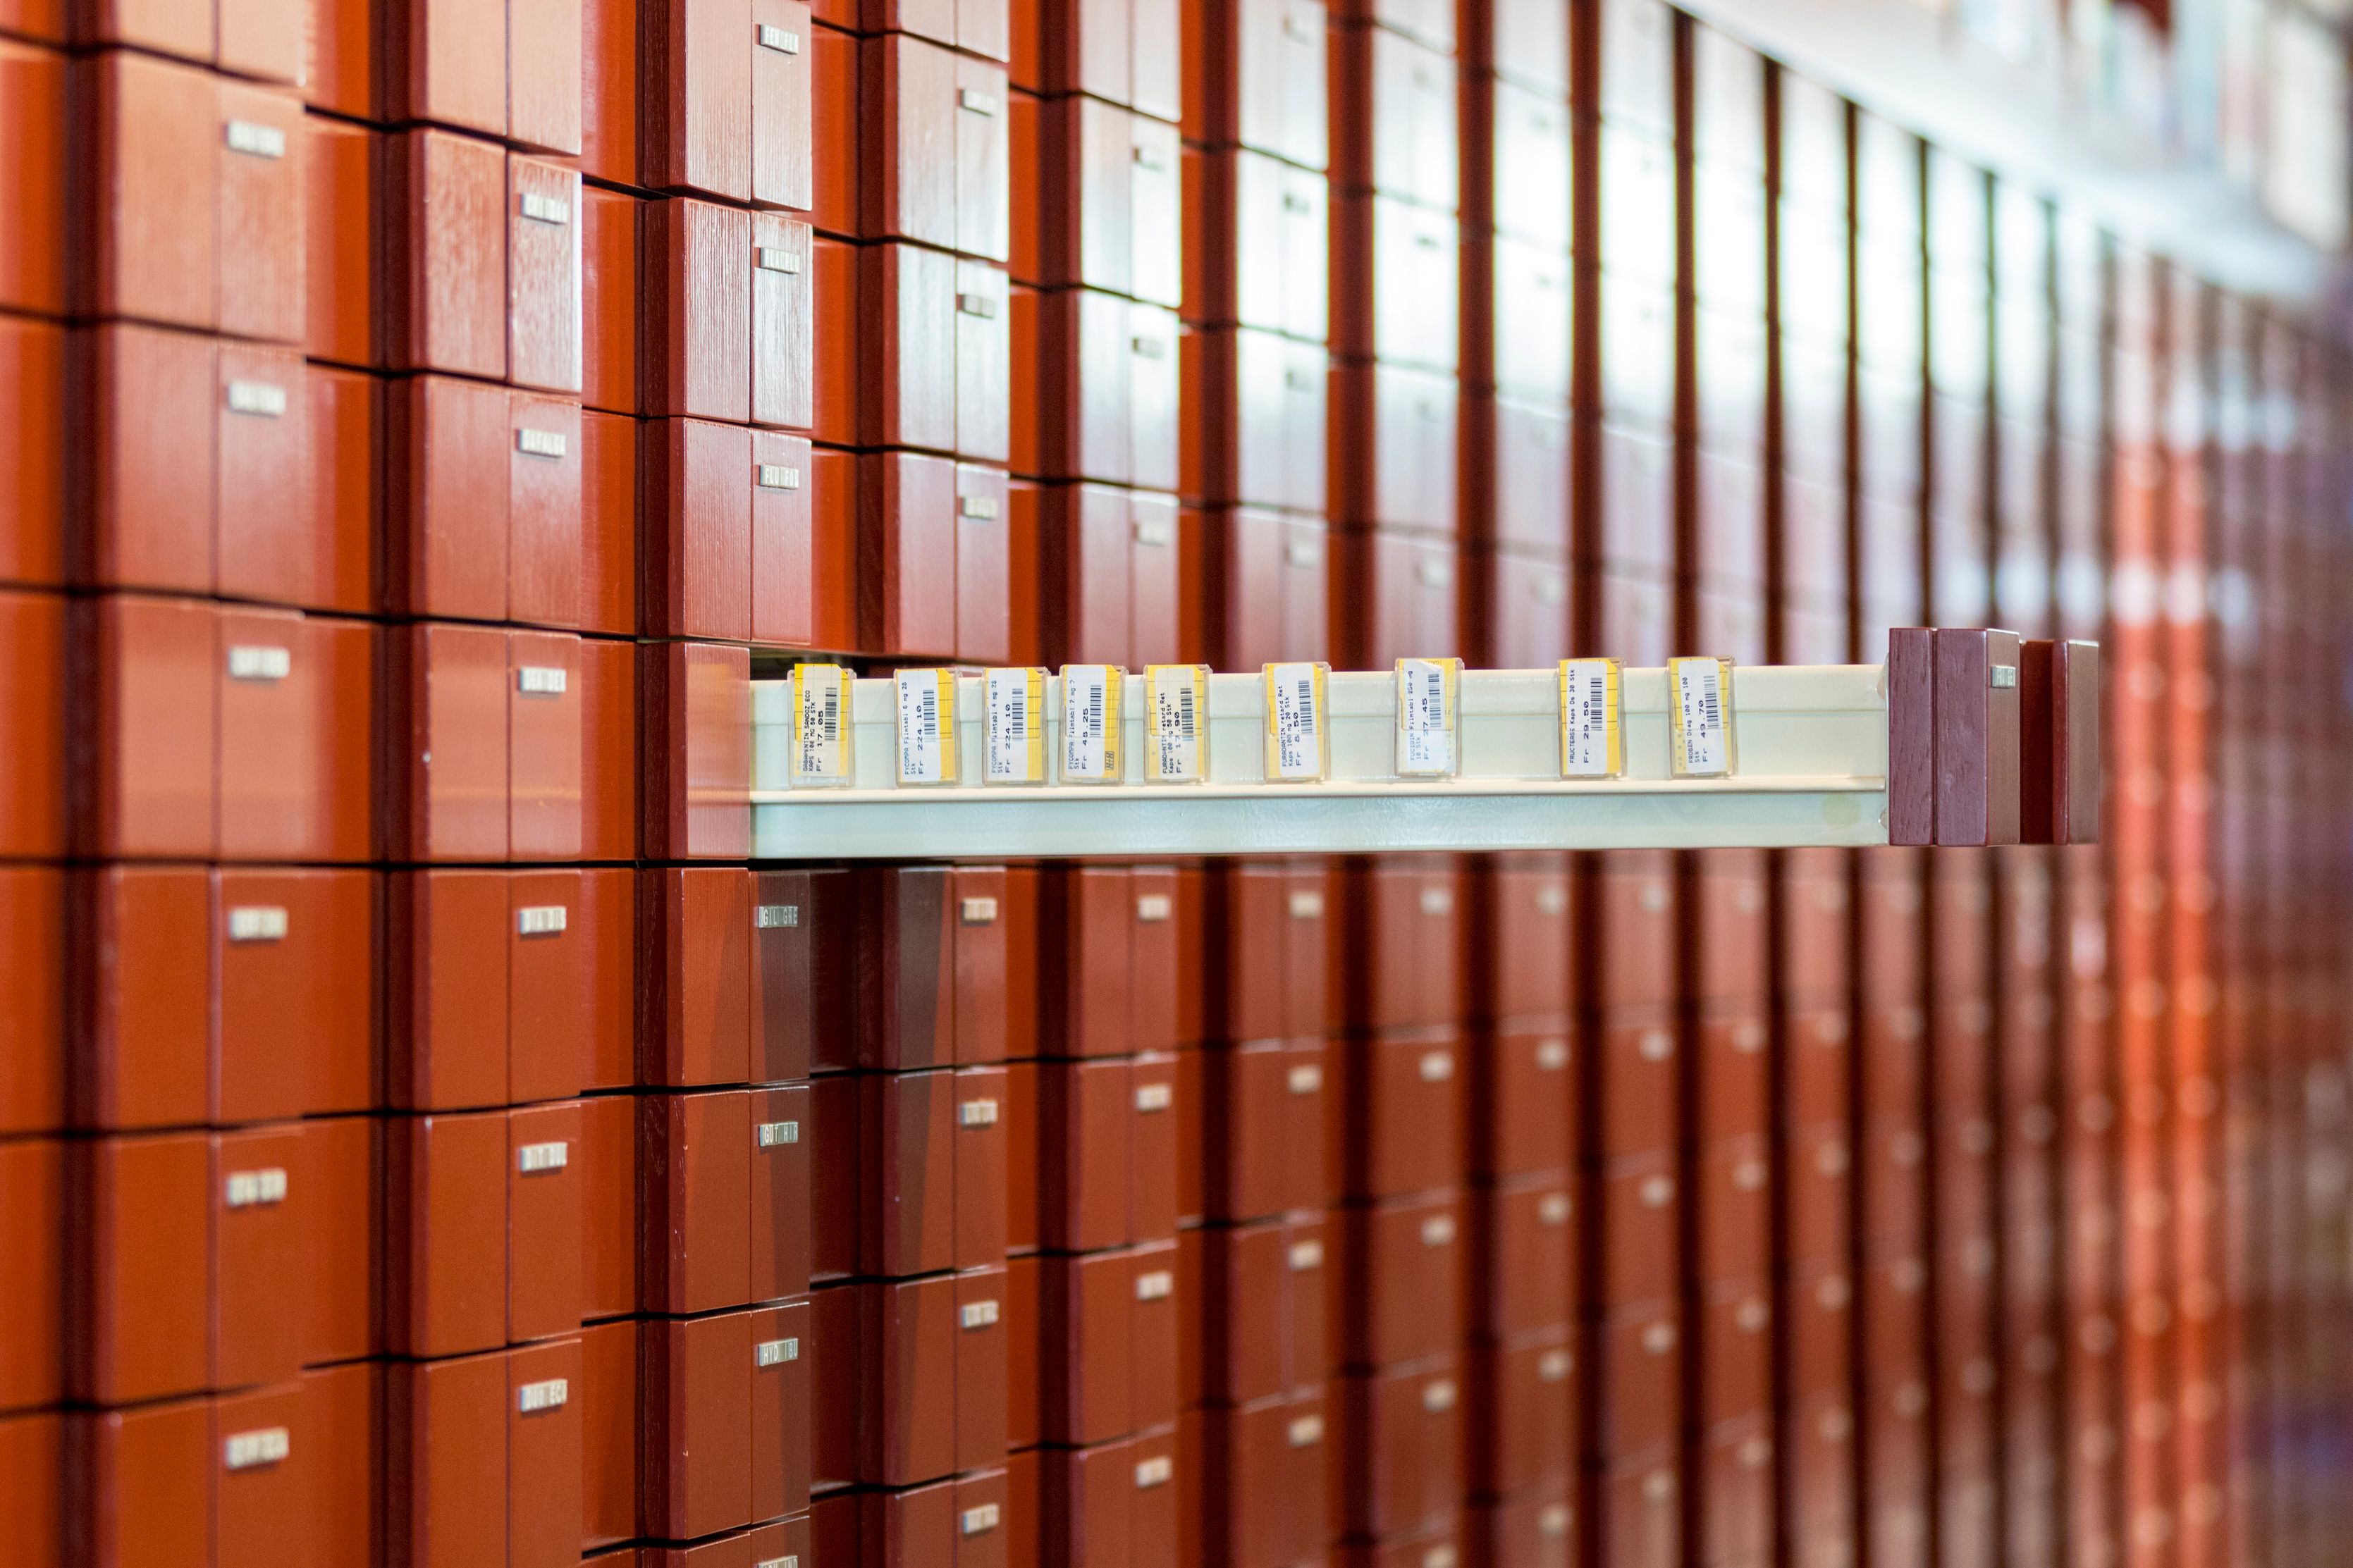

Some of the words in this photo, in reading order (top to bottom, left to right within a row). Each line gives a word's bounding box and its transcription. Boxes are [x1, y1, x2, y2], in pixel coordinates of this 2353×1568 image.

[764, 464, 780, 487] FLU
[902, 693, 908, 702] mg
[1569, 696, 1575, 705] Ds
[1684, 692, 1690, 700] mg
[1167, 719, 1172, 727] 50
[1286, 723, 1292, 731] mg
[809, 729, 815, 737] MG
[1296, 751, 1301, 766] Fr
[1423, 744, 1429, 760] Fr
[1583, 748, 1589, 763] Fr
[1702, 747, 1708, 763] Fr
[816, 757, 821, 772] Fr
[918, 760, 923, 774] Fr
[1005, 758, 1010, 773] Fr
[1081, 755, 1087, 770] Fr
[1176, 758, 1182, 773] Fr
[763, 907, 777, 925] GIL
[782, 906, 798, 925] GRE
[764, 1124, 778, 1144] GUT
[763, 1343, 779, 1364] HYD
